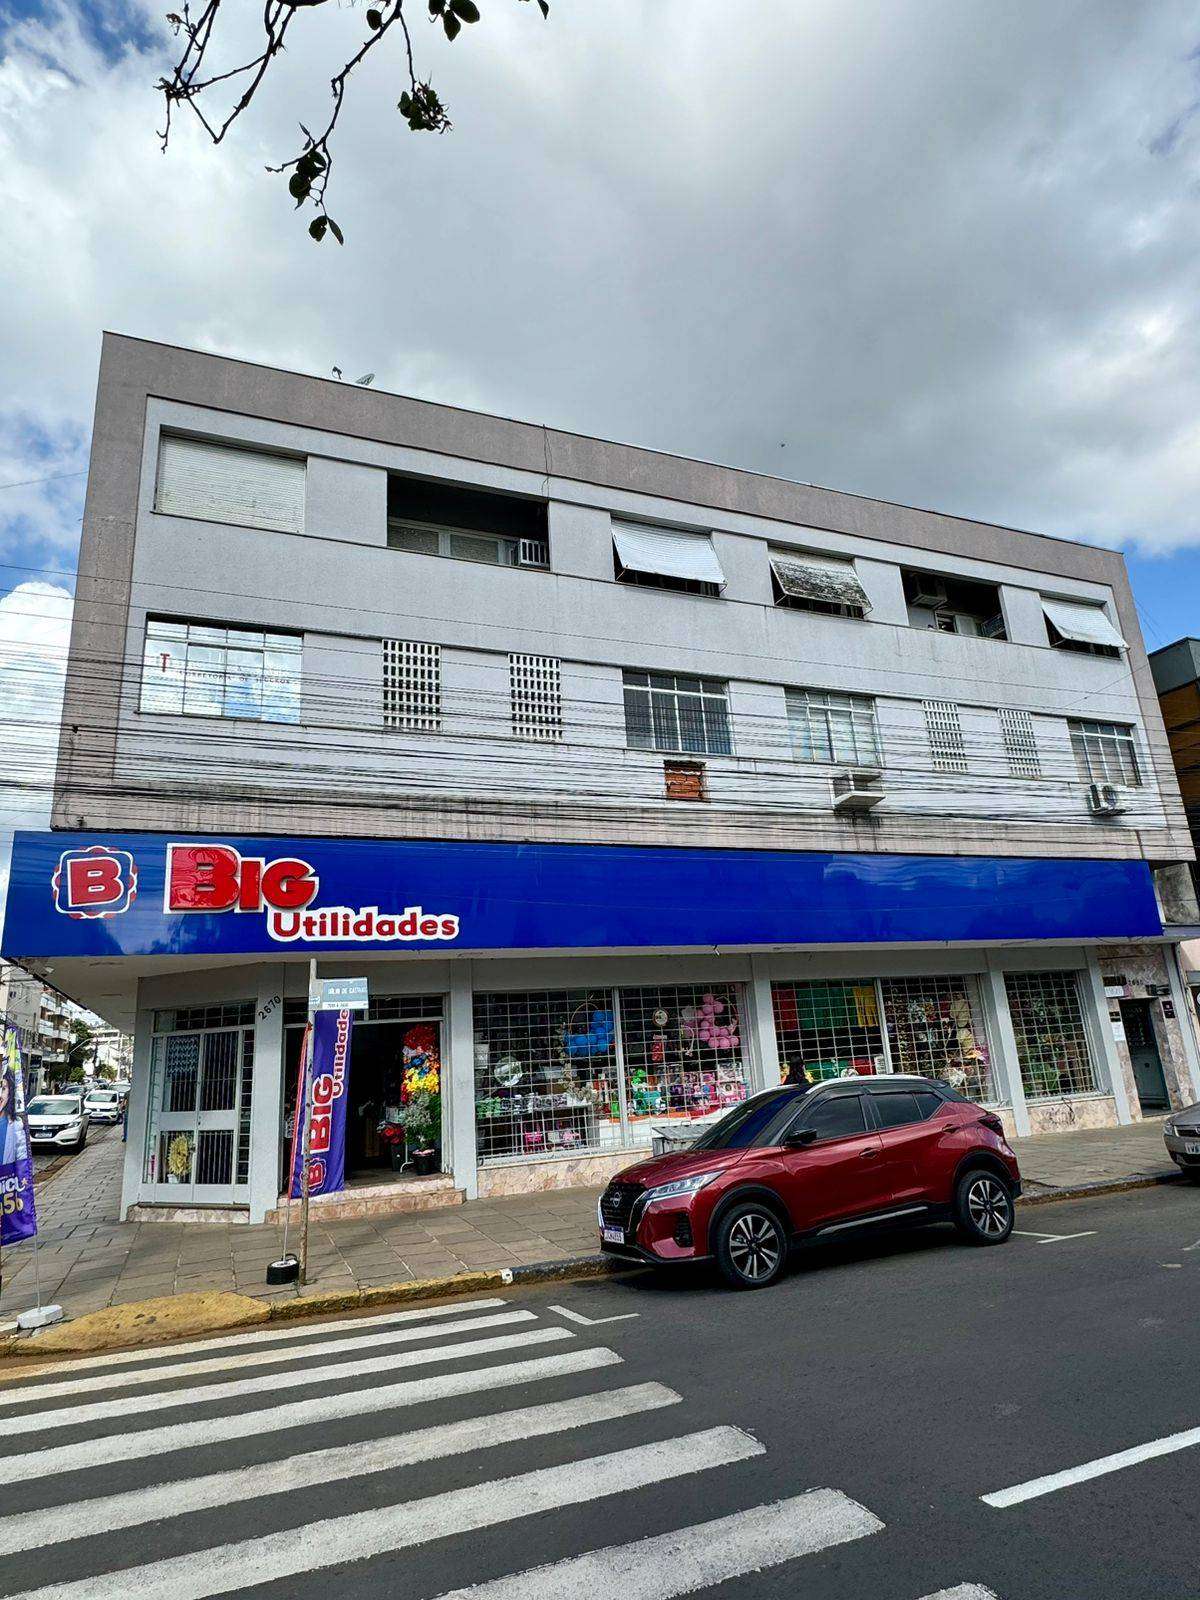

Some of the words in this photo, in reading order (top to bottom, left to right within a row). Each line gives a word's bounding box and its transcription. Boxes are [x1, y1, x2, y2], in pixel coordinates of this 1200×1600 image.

[67, 857, 124, 907] B
[164, 843, 319, 913] BIG
[270, 908, 459, 941] Utilidades
[258, 995, 281, 1020] 2670
[308, 1074, 333, 1152] BIG
